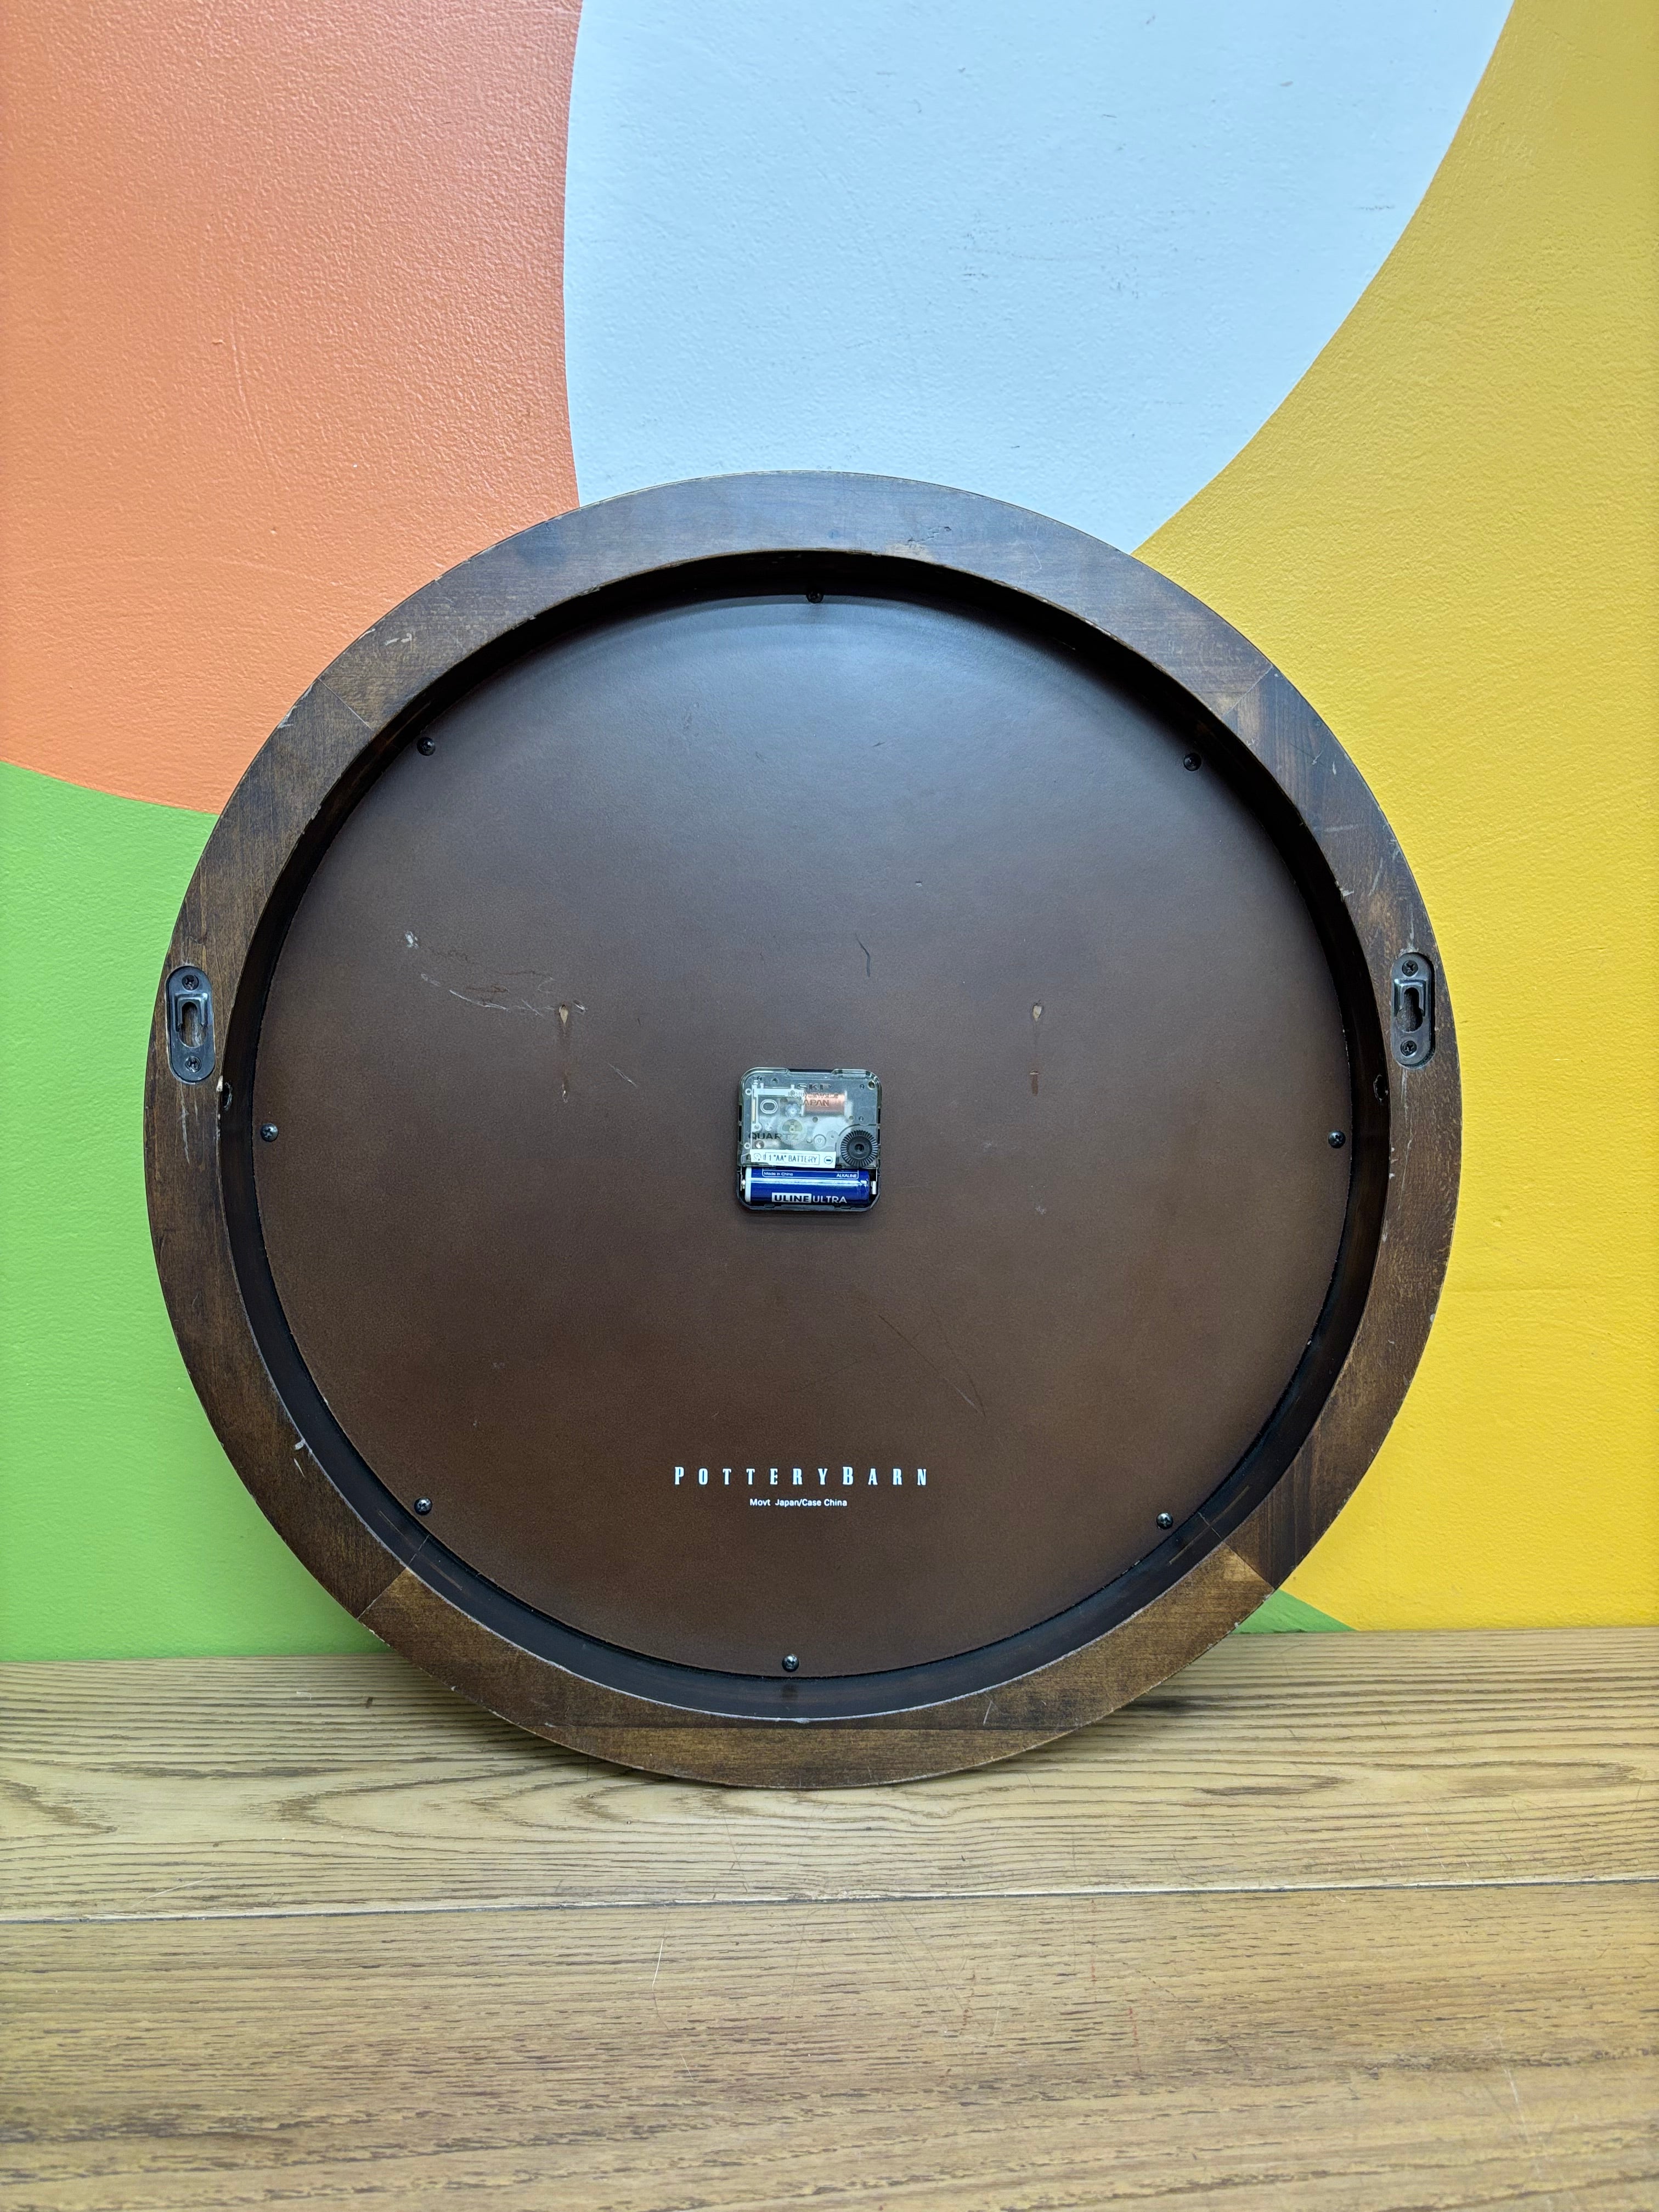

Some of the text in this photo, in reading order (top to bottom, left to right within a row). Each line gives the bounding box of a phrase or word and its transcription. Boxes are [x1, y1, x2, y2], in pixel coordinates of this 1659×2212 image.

[748, 1132, 799, 1141] QUARTZ
[788, 1155, 817, 1163] BATTERY
[774, 1194, 847, 1204] ULINE ULTRA
[750, 1498, 771, 1506] Movt
[775, 1498, 822, 1508] Japan/Case
